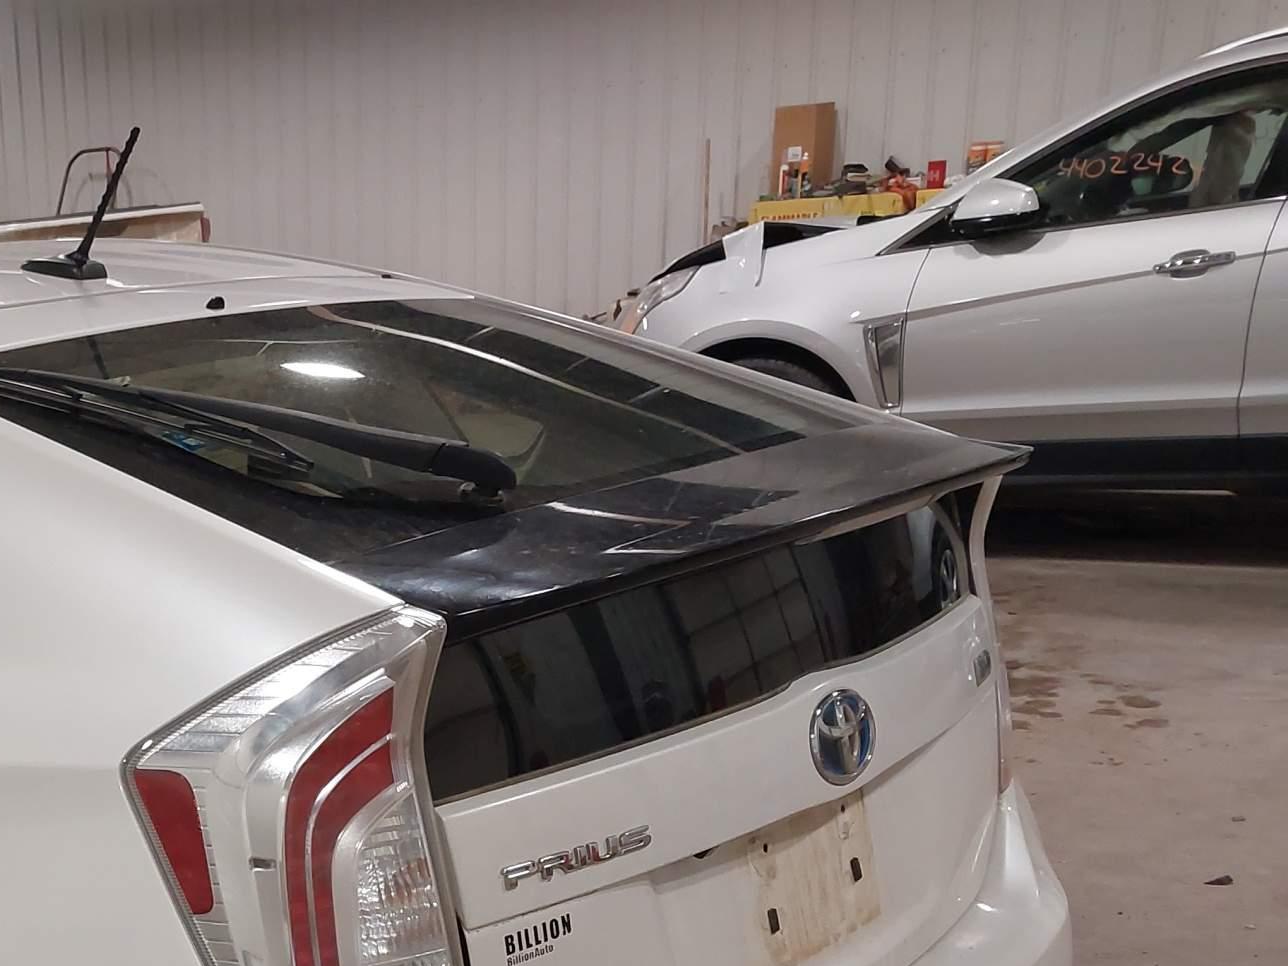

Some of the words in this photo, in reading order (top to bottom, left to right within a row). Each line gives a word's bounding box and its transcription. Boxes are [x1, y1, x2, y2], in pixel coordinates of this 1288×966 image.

[500, 824, 652, 891] PRIUS
[504, 913, 573, 956] BILLION
[506, 943, 554, 966] BillionAuto
